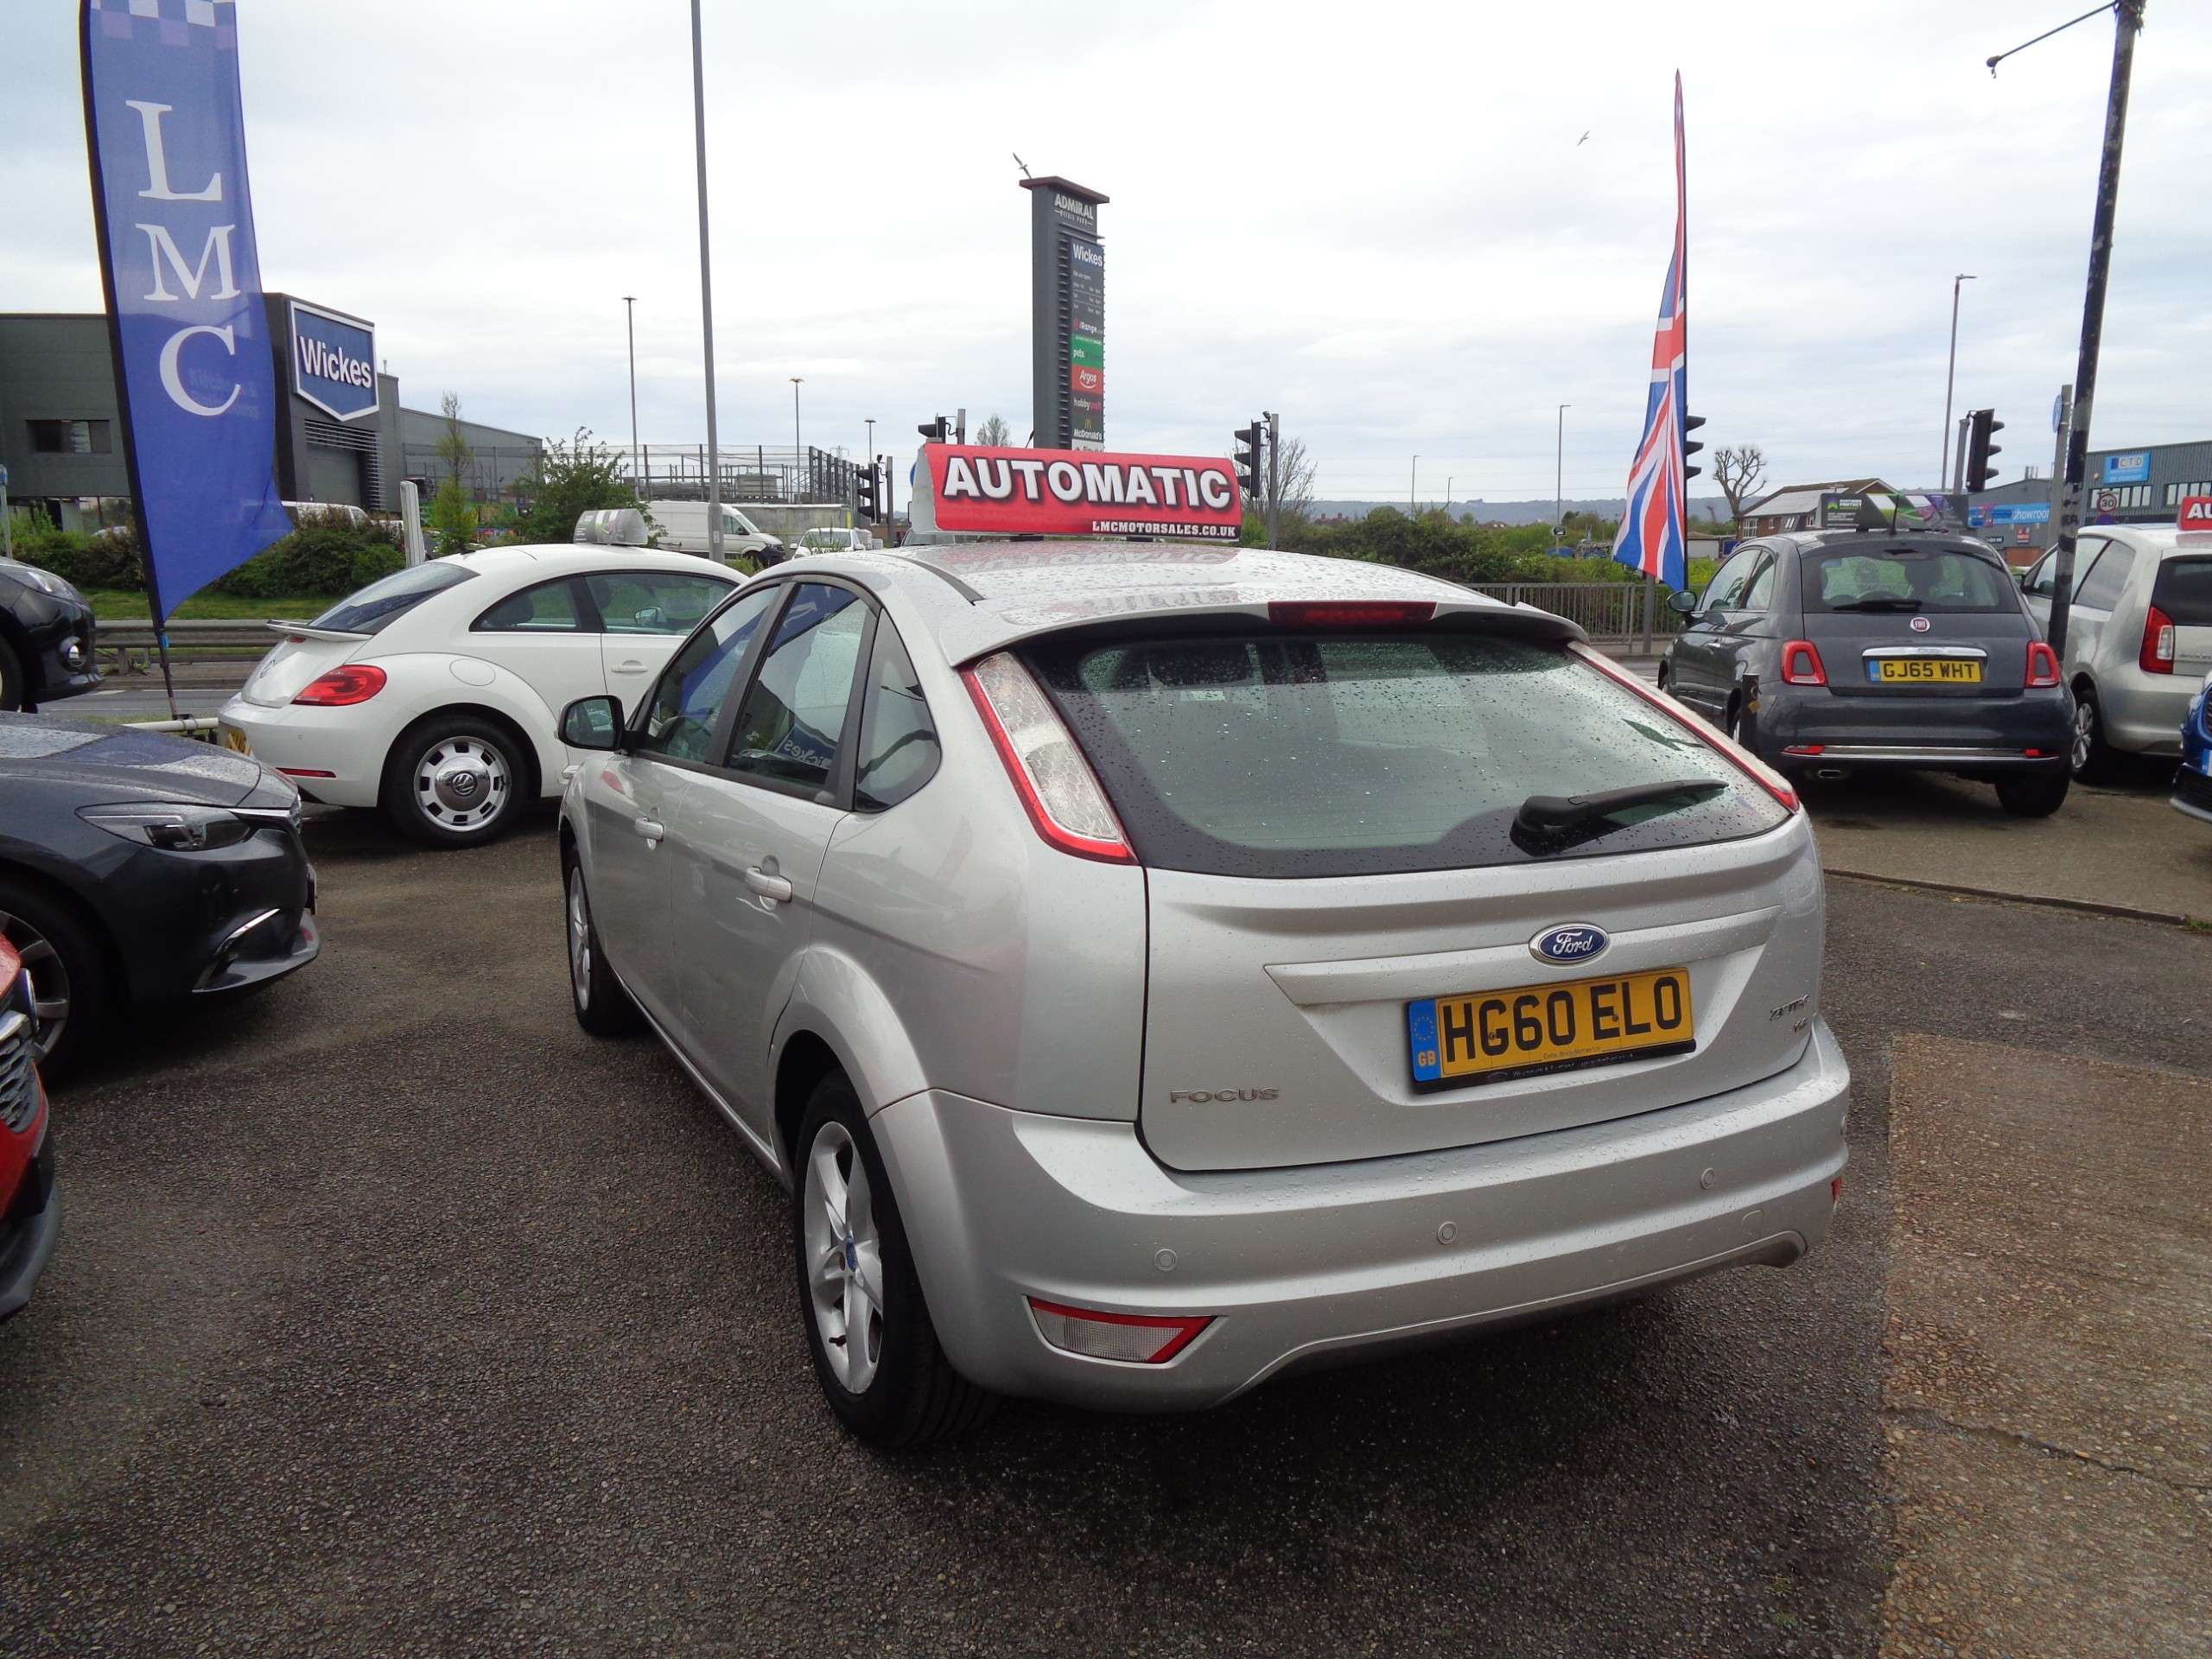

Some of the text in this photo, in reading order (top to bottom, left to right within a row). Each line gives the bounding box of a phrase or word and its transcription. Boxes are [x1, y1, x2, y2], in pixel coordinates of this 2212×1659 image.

[1054, 194, 1093, 220] ADMIRAL
[1073, 244, 1103, 266] Wickes
[300, 335, 372, 389] Wickes
[1080, 370, 1096, 384] Argos
[944, 458, 1230, 508] AUTOMATIC
[2101, 499, 2113, 508] 30
[1092, 520, 1236, 537] LMCMOTORSALES.CO.UK
[1884, 663, 1974, 678] GJ65 WHT
[1553, 931, 1592, 955] Ford
[1443, 976, 1681, 1063] HG60 ELO
[1418, 1051, 1436, 1067] GB
[1170, 1087, 1279, 1103] FOCUS
